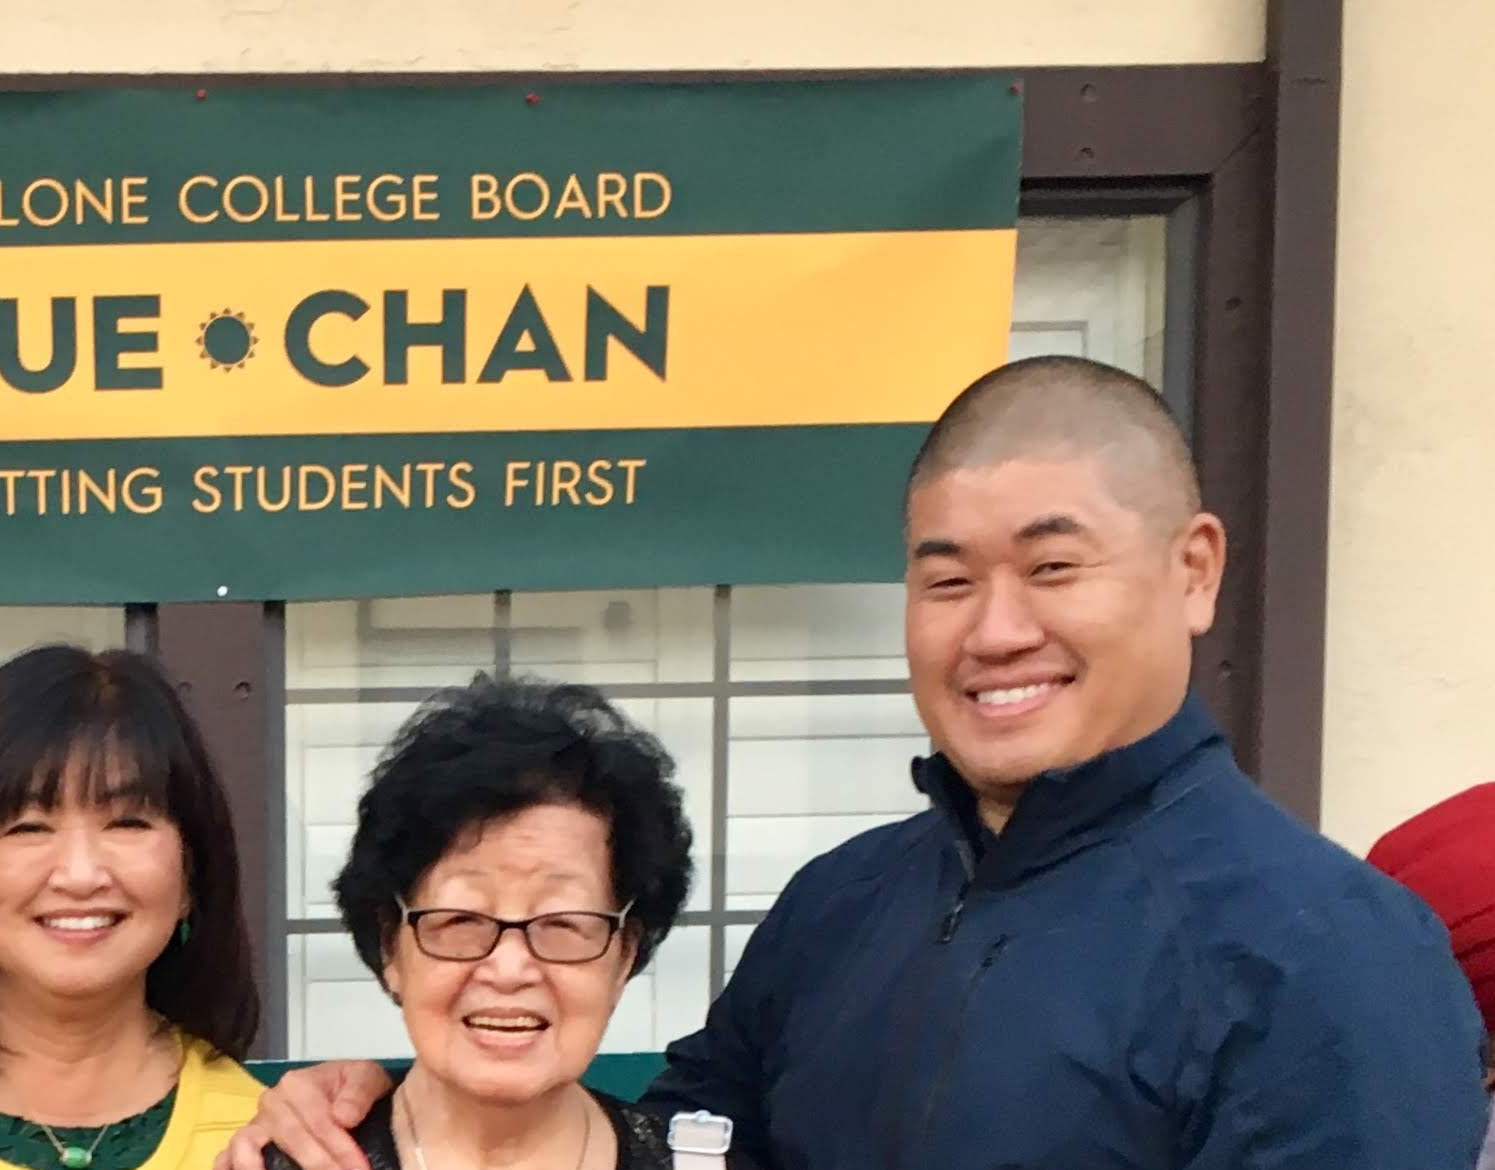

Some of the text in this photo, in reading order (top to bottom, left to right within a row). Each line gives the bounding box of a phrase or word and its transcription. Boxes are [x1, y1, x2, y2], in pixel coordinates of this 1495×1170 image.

[178, 173, 441, 224] COLLEGE
[471, 172, 673, 220] BOARD
[284, 284, 670, 387] CHAN
[191, 461, 476, 513] STUDENTS
[504, 459, 648, 507] FIRST
